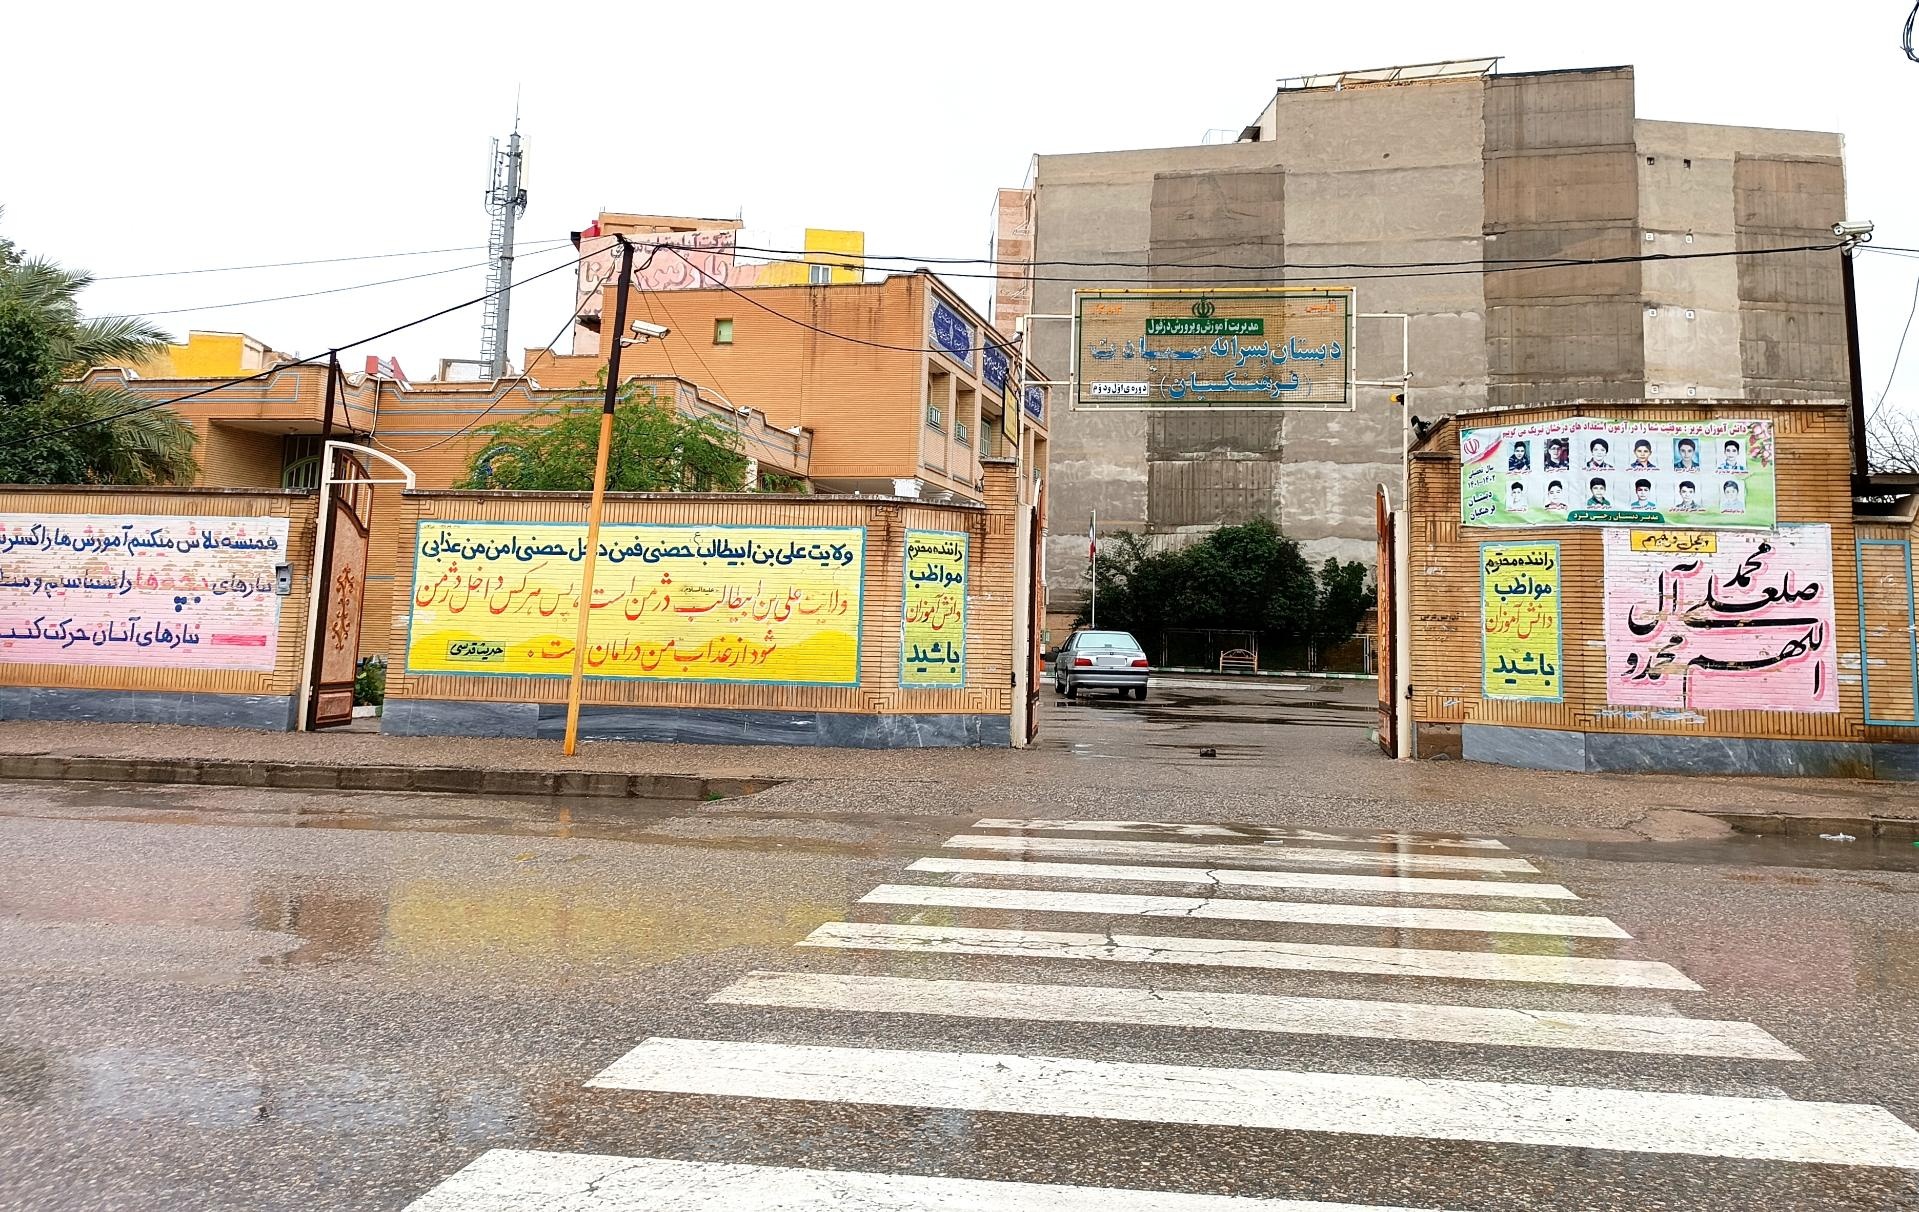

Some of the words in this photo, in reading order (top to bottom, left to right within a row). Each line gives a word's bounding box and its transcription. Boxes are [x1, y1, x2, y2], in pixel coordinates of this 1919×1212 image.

[1148, 319, 1170, 334] دزفول
[1170, 320, 1195, 333] پرورش
[1201, 319, 1228, 334] آموزش
[1228, 321, 1259, 334] مدیریت
[1210, 335, 1270, 368] پسرانه
[1270, 336, 1342, 367] دبستان
[1607, 422, 1628, 433] آزمون
[1705, 424, 1727, 435] آموزان
[1729, 424, 1746, 435] دانش
[1468, 491, 1492, 507] دبستان
[421, 530, 461, 562] عذابی
[461, 537, 486, 560] من
[515, 536, 569, 561] حصنی
[608, 535, 643, 563] فمن
[642, 540, 696, 563] حصنی
[696, 538, 752, 567] ابیطالب
[752, 544, 775, 567] بن
[776, 541, 807, 565] علی
[808, 543, 854, 567] ولایت
[907, 539, 933, 561] محترم
[932, 541, 963, 562] راننده
[1484, 552, 1518, 575] محترم
[1518, 551, 1555, 571] راننده
[908, 563, 963, 589] مواظب
[1494, 572, 1553, 602] مواظب
[416, 574, 448, 606] من
[624, 587, 659, 621] من
[773, 585, 802, 623] علی
[905, 592, 944, 624] آموزان
[931, 595, 962, 631] دانش
[1484, 600, 1525, 634] آموزان
[1517, 602, 1553, 640] دانش
[44, 617, 91, 649] حرکت
[449, 642, 477, 656] قدسی
[477, 642, 504, 661] حدیث
[640, 638, 676, 672] من
[727, 636, 749, 667] از
[750, 628, 777, 665] شود
[906, 641, 961, 674] باشید
[1492, 651, 1556, 687] باشید
